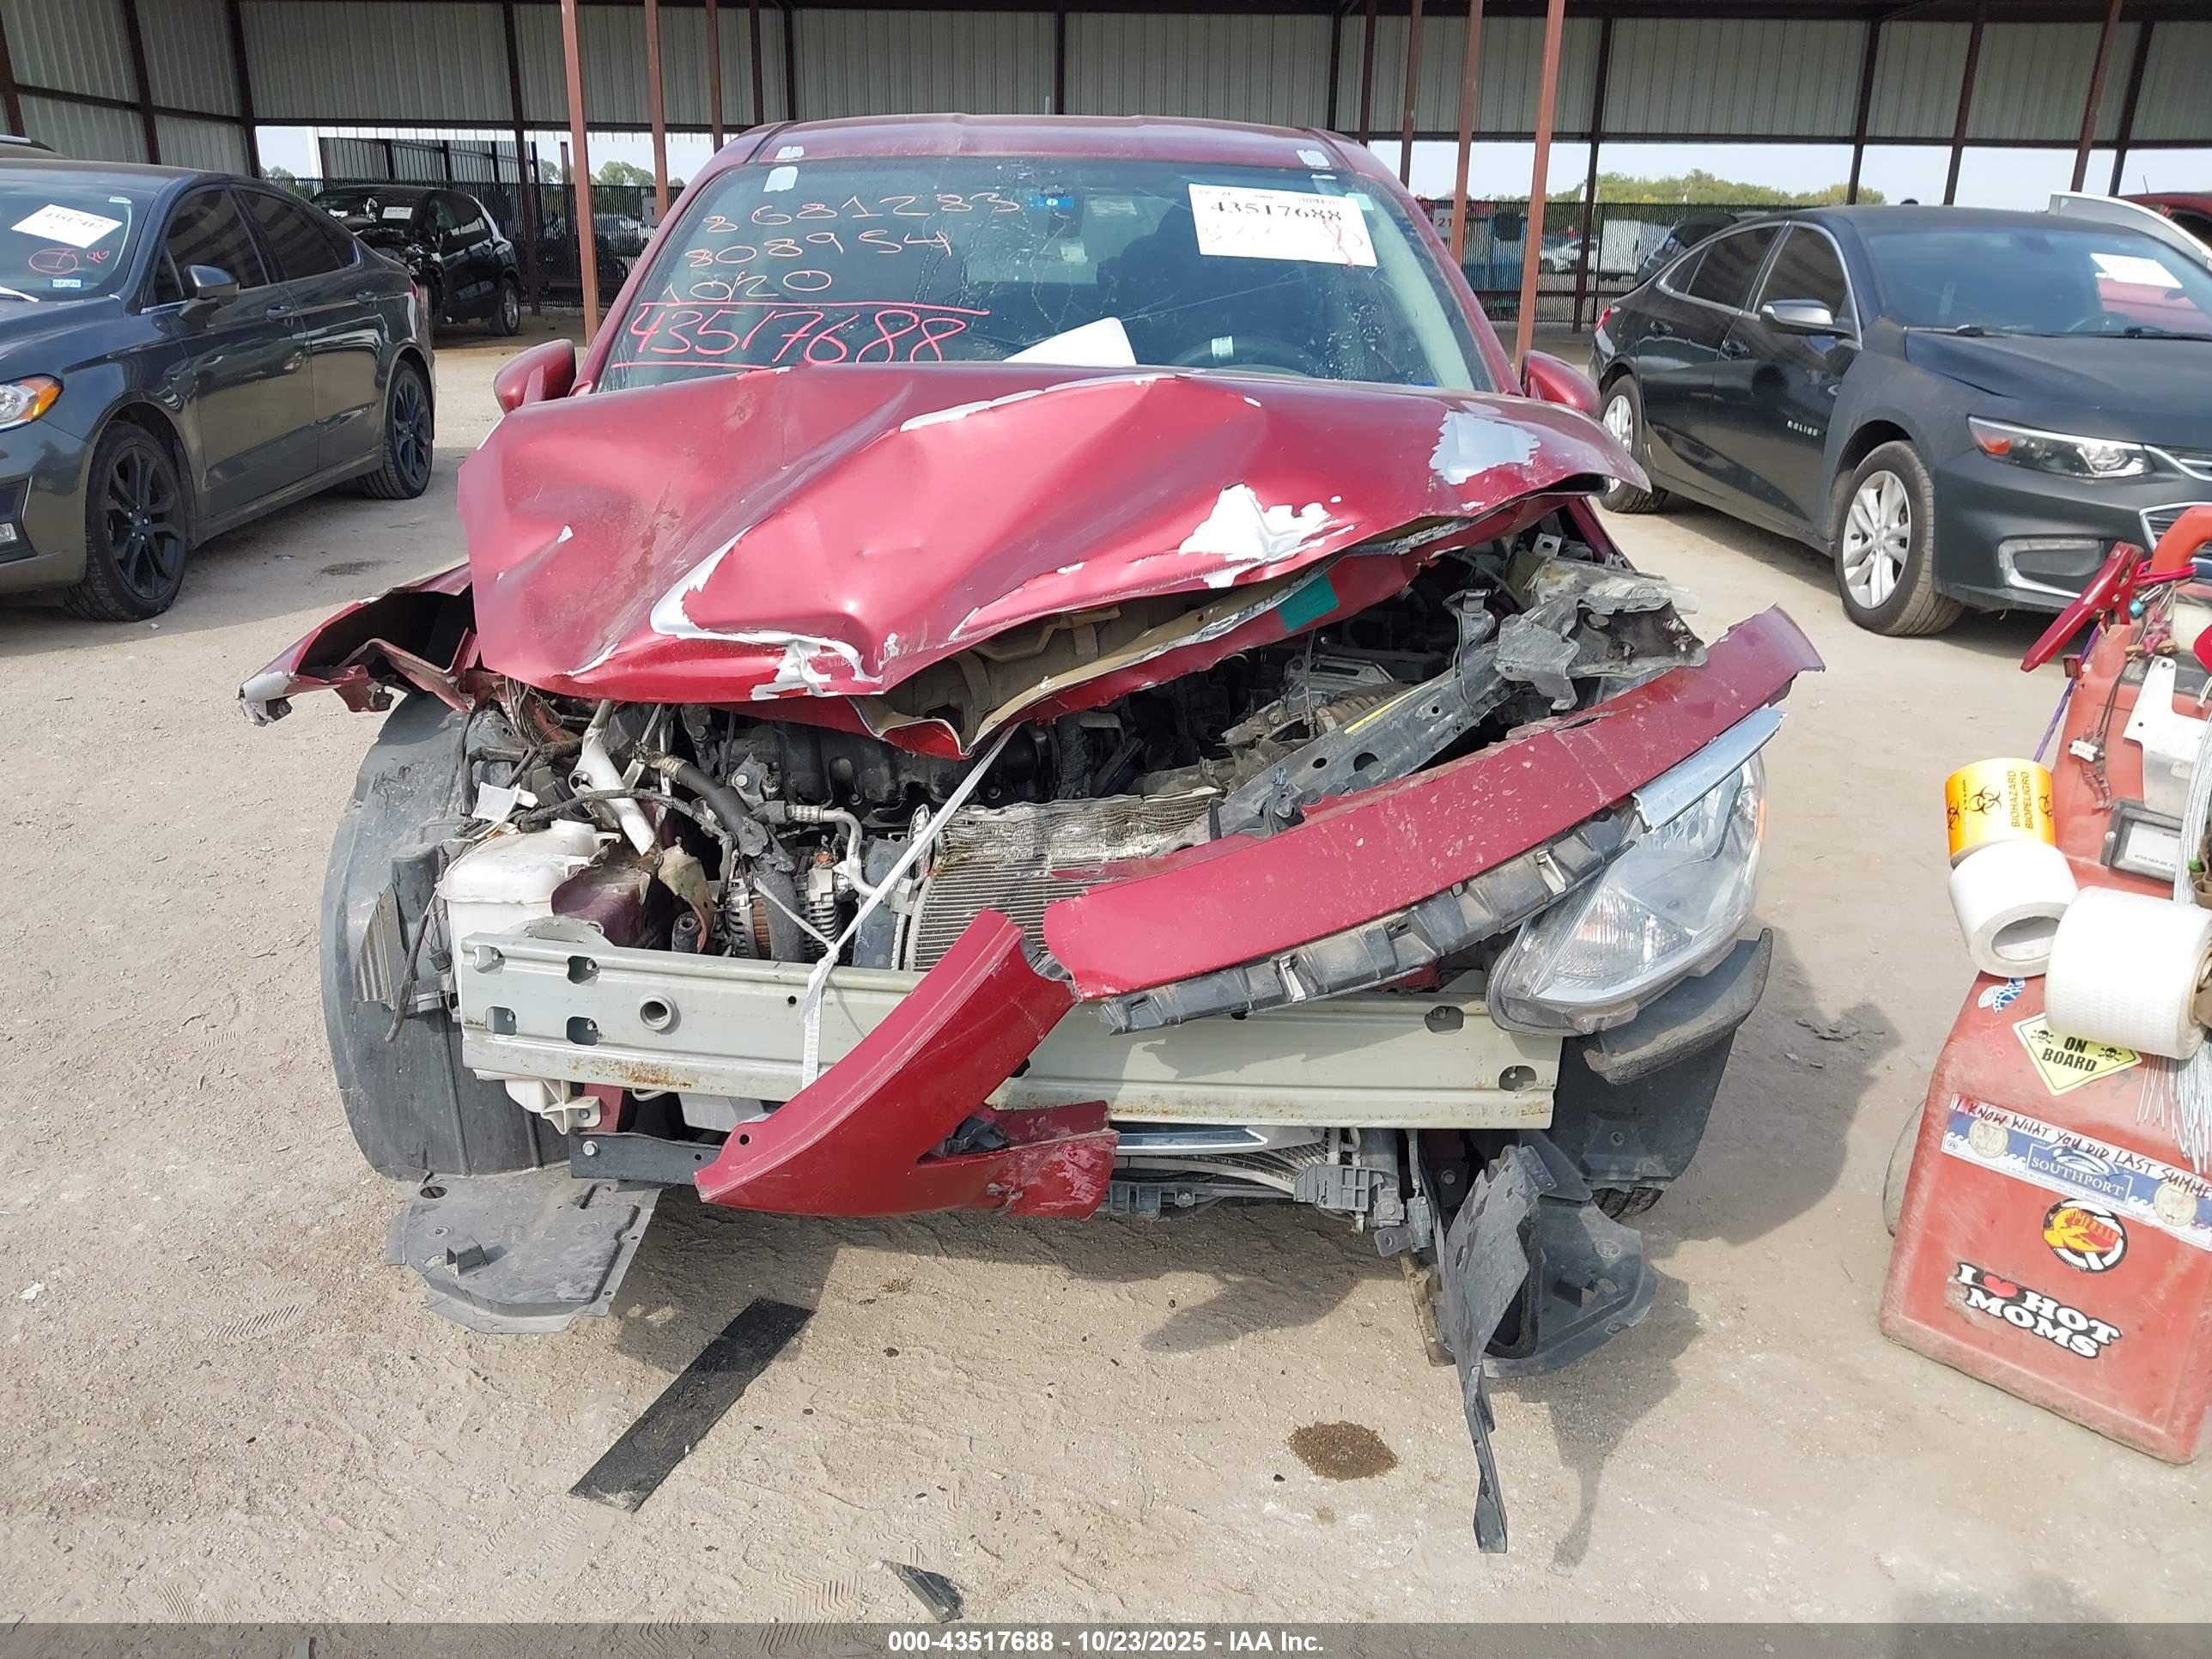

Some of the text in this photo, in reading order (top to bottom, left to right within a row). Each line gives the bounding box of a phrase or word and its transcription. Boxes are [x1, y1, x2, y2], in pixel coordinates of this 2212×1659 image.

[629, 309, 967, 364] 43517688
[2007, 770, 2021, 828] BIOHAZARD
[2021, 771, 2033, 830] BIOPELIGRO
[2041, 1048, 2098, 1073] BOARD
[2063, 1036, 2089, 1054] ON
[1967, 1102, 2008, 1126] KNOW
[2011, 1118, 2052, 1139] WHAT
[2085, 1143, 2111, 1161] DID
[2113, 1149, 2158, 1176] LAST
[2030, 1157, 2126, 1197] SOUTHPORT
[1958, 1263, 2121, 1345] I HOT
[1966, 1288, 2099, 1358] MOMS
